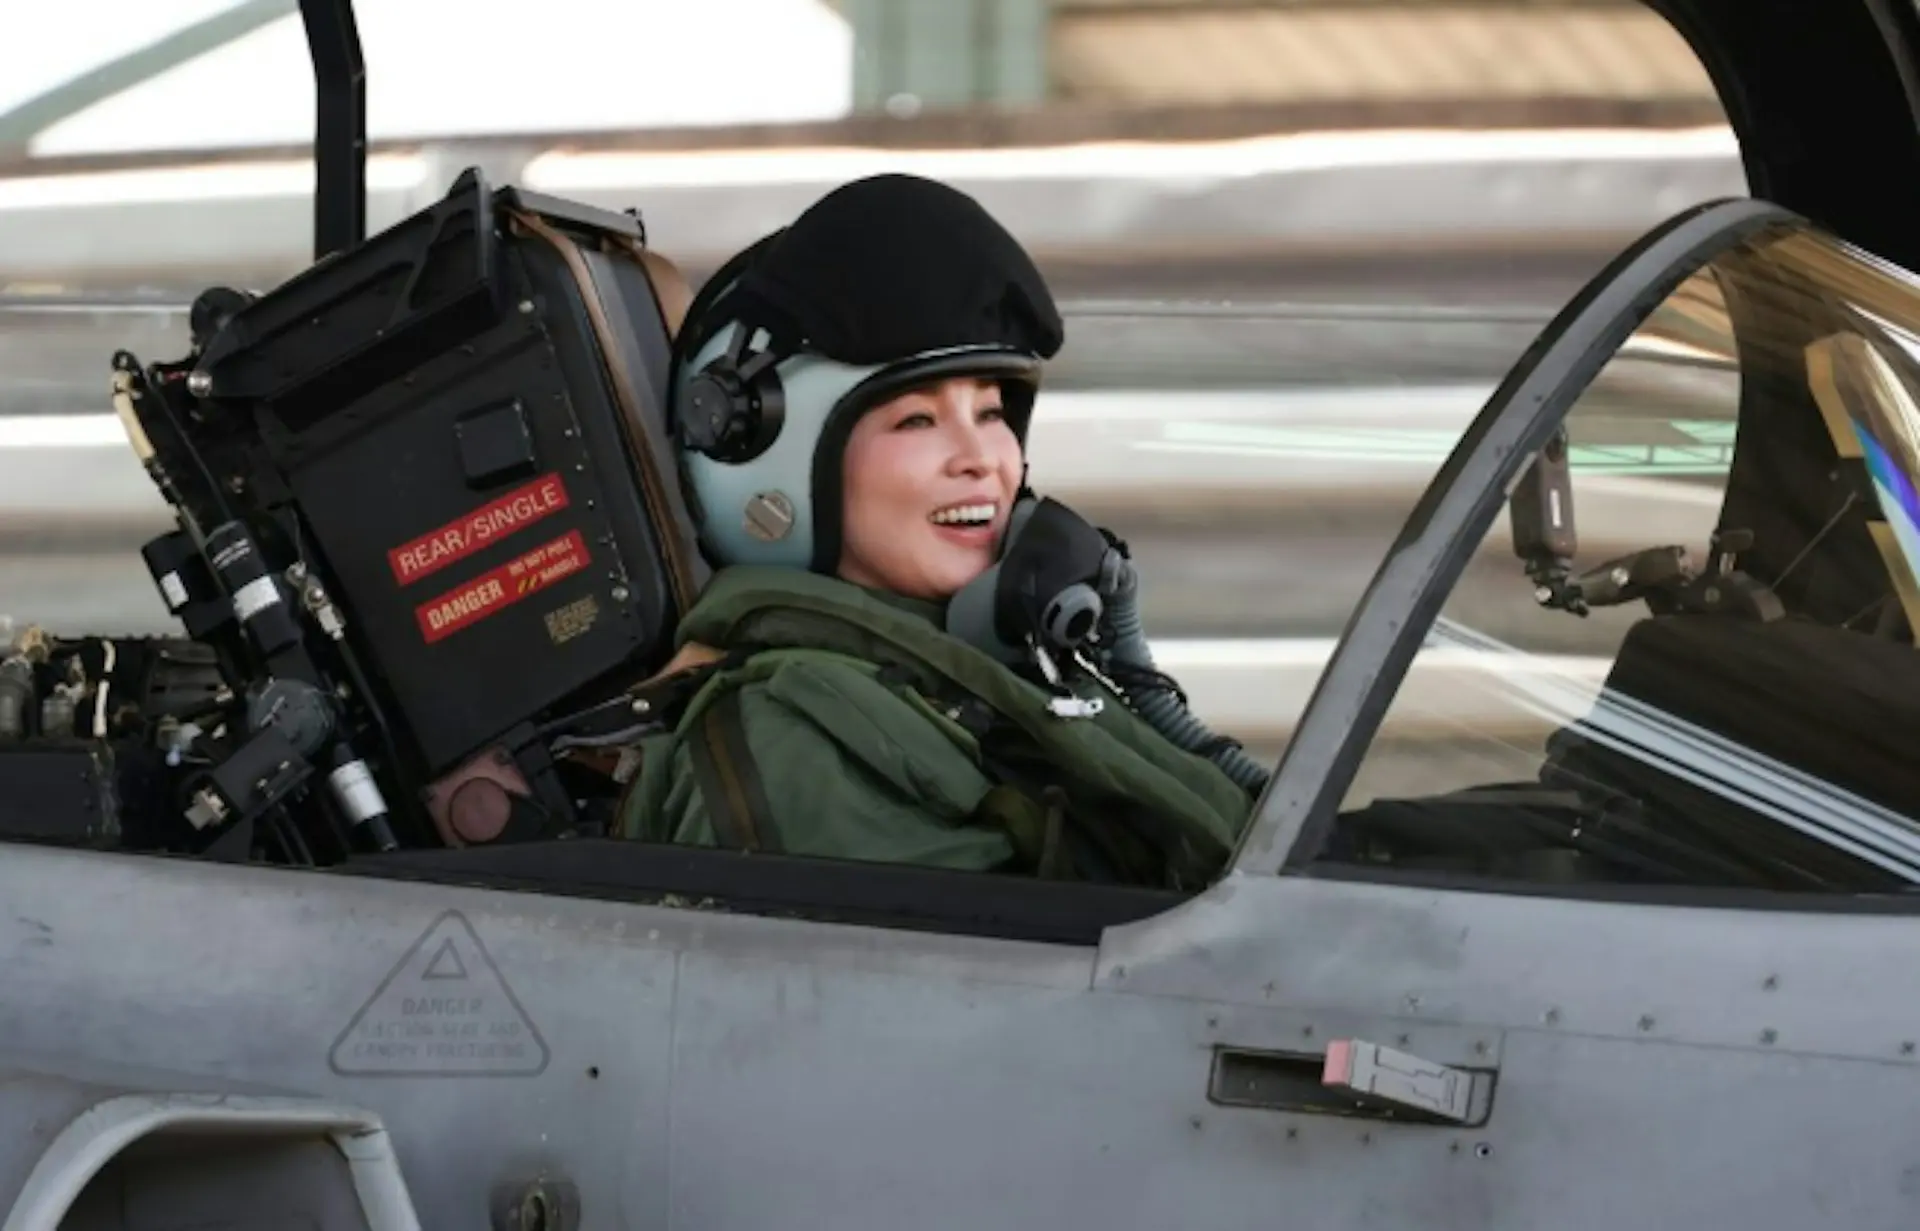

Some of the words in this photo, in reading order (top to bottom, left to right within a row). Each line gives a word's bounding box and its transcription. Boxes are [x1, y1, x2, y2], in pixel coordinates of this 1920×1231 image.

[398, 483, 560, 576] REAR/SINGLE
[427, 579, 504, 630] DANGER
[402, 998, 483, 1015] DANGER
